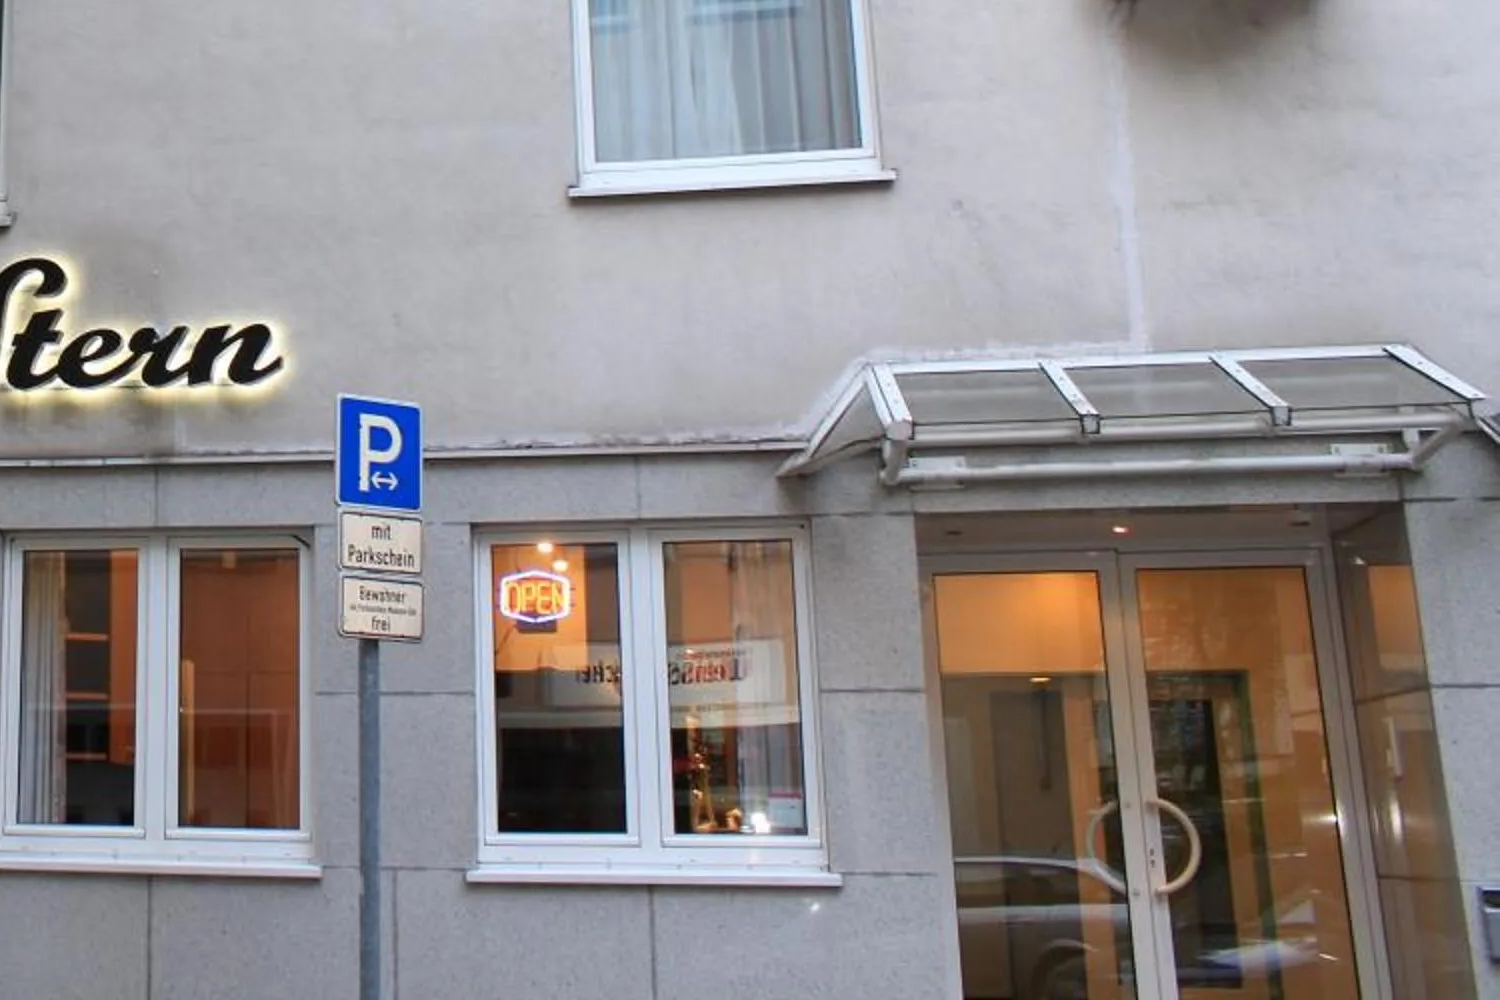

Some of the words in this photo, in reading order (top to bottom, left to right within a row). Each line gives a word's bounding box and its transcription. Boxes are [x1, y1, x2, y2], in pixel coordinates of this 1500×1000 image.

[358, 413, 403, 492] P
[371, 523, 392, 541] mit
[347, 543, 415, 569] Parkschein
[503, 580, 568, 616] OPEN
[371, 615, 392, 633] frei
